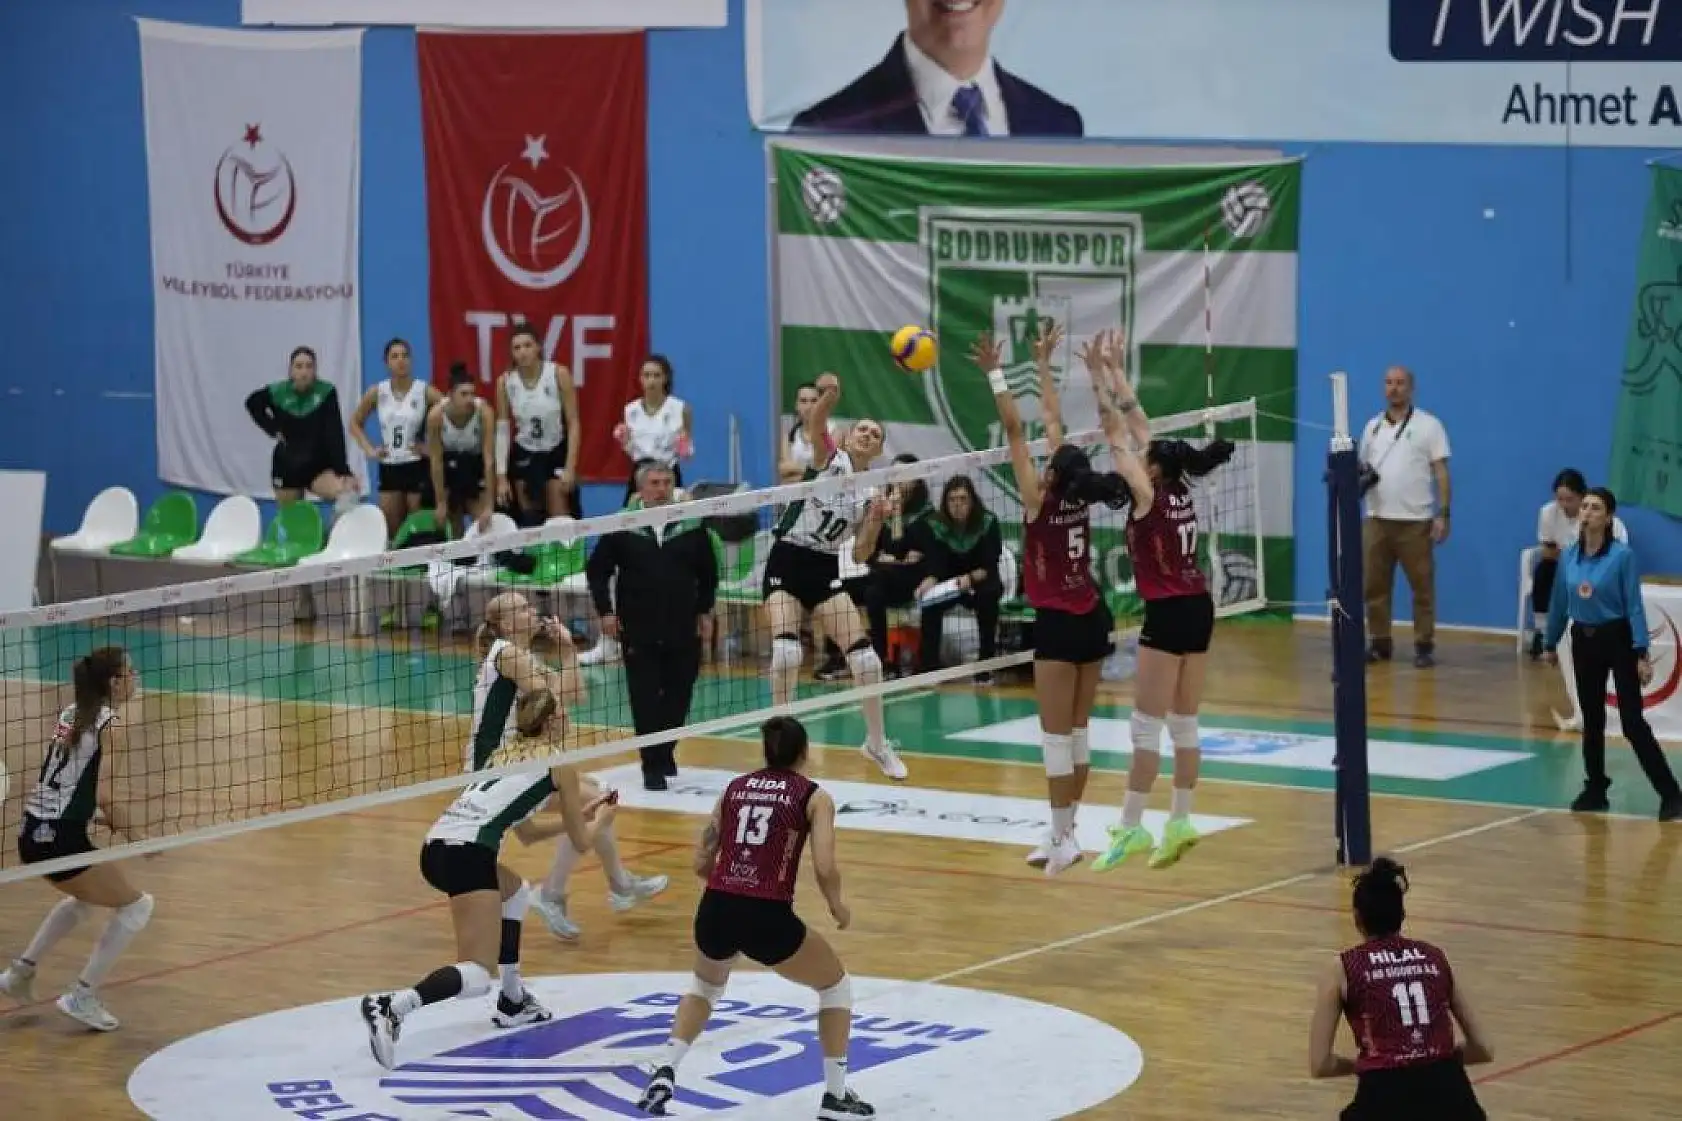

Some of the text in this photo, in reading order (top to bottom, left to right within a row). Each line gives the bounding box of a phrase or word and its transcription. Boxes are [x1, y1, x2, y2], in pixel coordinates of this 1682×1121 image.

[1479, 0, 1661, 46] WISH
[1501, 82, 1638, 125] Ahmet
[937, 227, 1127, 267] BODRUMSPOR
[225, 260, 288, 280] TÜRKİYE
[244, 283, 354, 300] FEDERASYOU
[392, 425, 403, 449] 6
[530, 416, 543, 439] 3
[810, 509, 848, 543] 10
[1068, 526, 1085, 560] 5
[1177, 521, 1198, 556] 17
[39, 736, 70, 790] 12
[735, 805, 774, 845] 13
[625, 992, 991, 1042] BODUM
[1392, 982, 1431, 1026] 11
